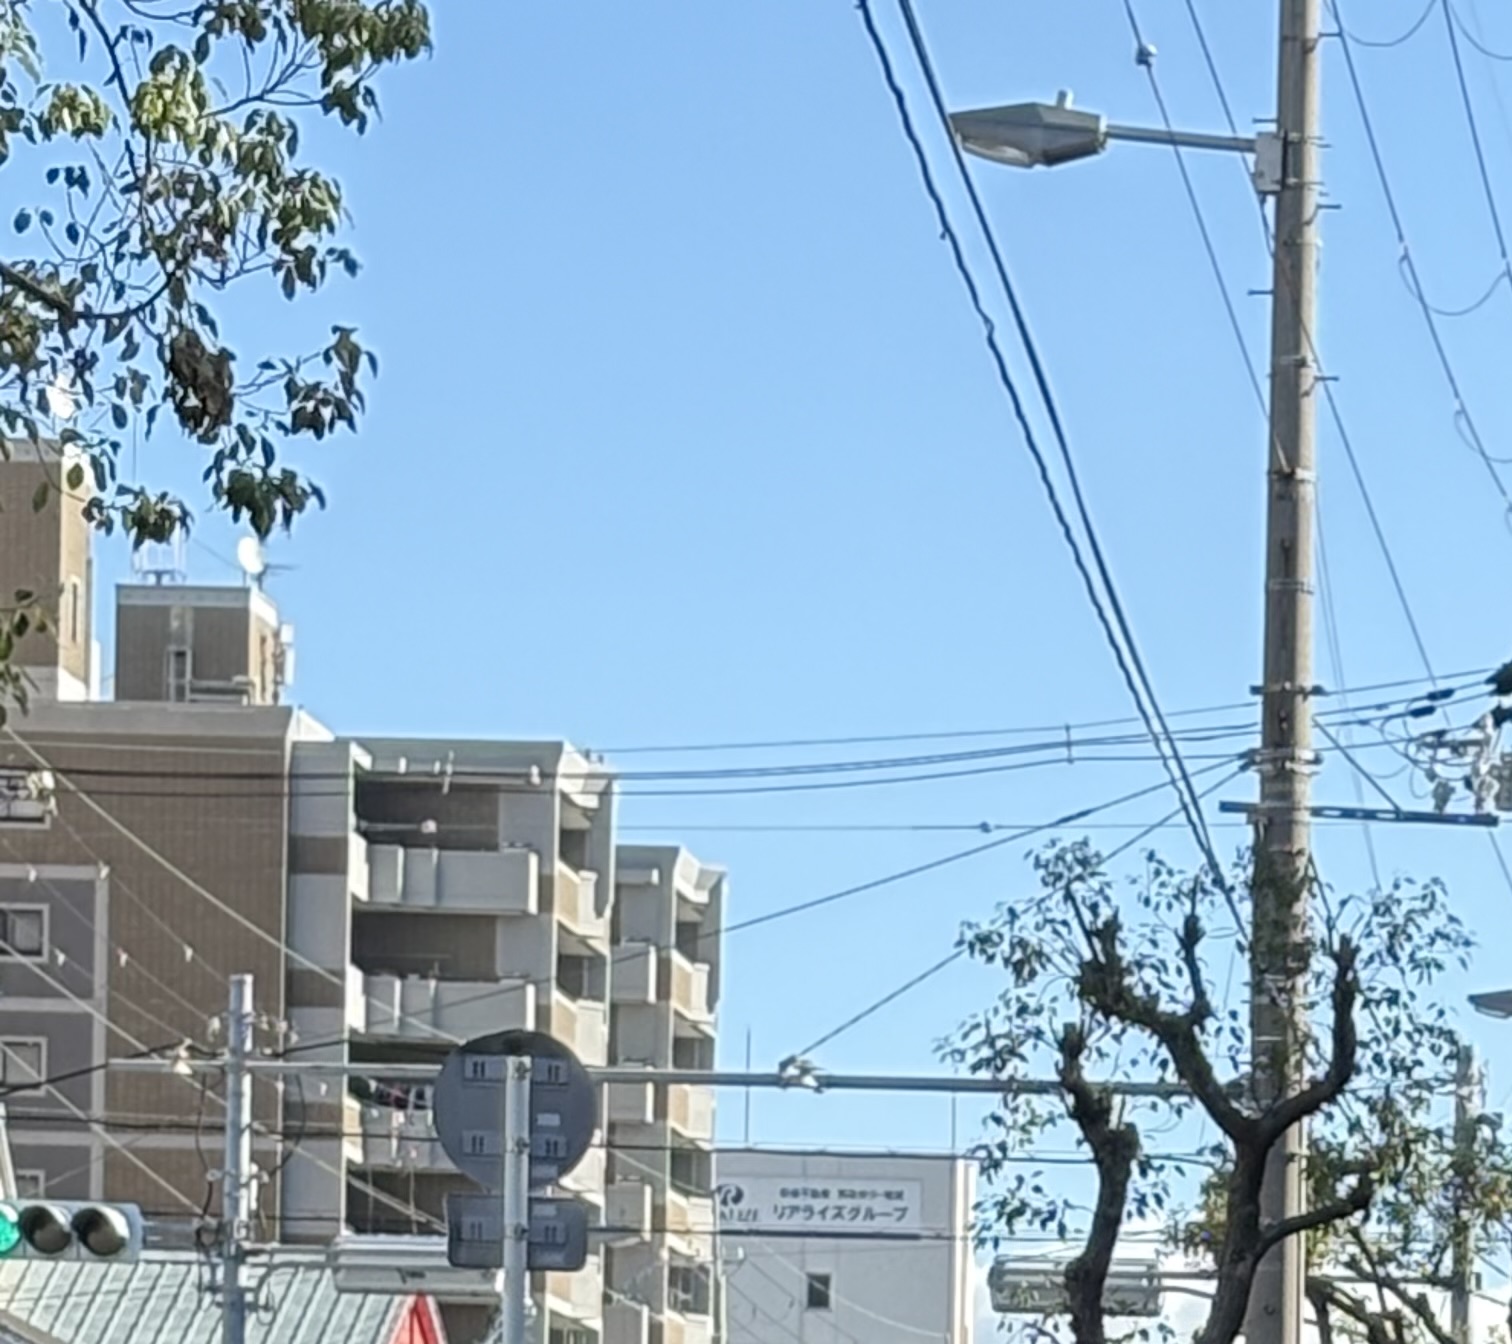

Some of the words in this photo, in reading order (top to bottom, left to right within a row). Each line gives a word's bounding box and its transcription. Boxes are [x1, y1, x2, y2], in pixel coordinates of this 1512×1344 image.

[772, 1203, 910, 1223] リアライズグループ
